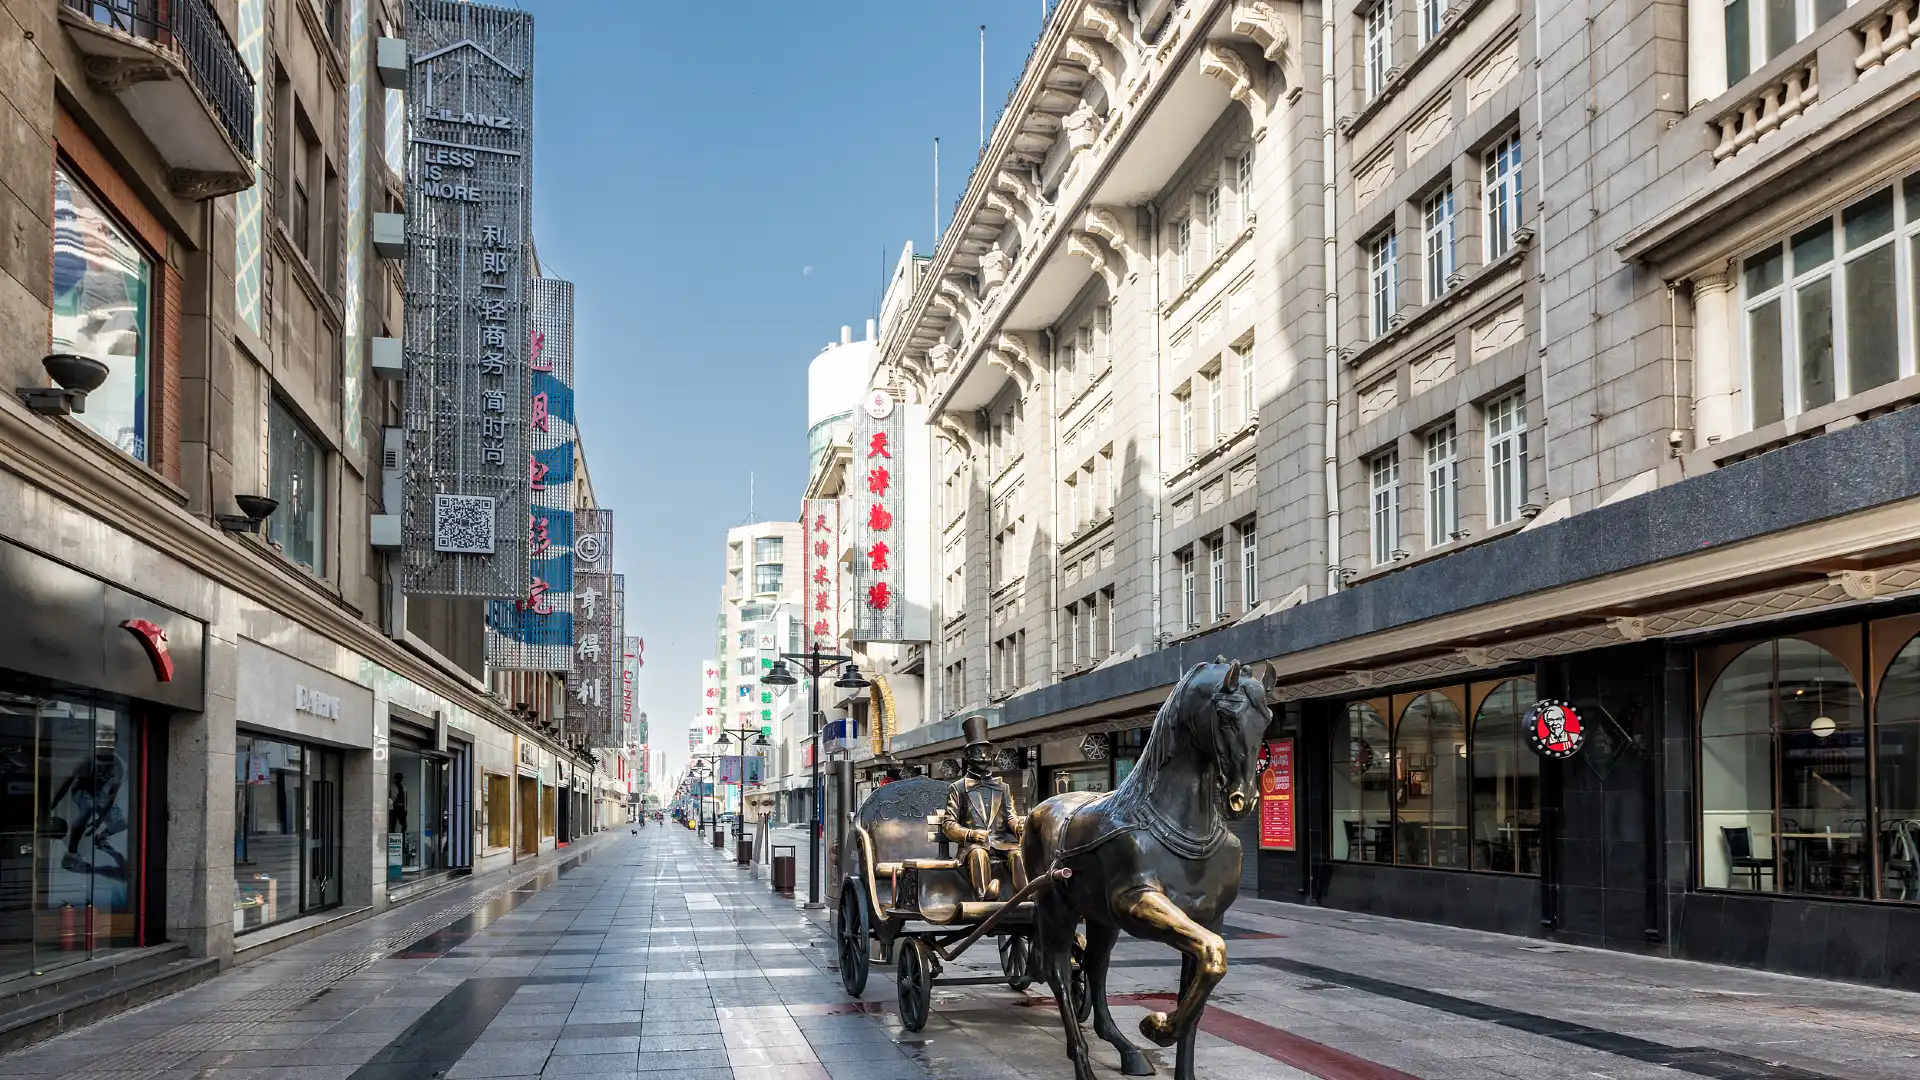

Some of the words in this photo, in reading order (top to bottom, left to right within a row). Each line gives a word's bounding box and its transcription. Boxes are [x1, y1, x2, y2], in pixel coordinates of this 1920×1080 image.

[426, 106, 512, 130] LILANZ
[426, 147, 475, 168] LESS
[425, 164, 443, 181] IS
[425, 181, 481, 202] MORE
[481, 387, 508, 467] 简时尚
[575, 587, 602, 708] 亨得利
